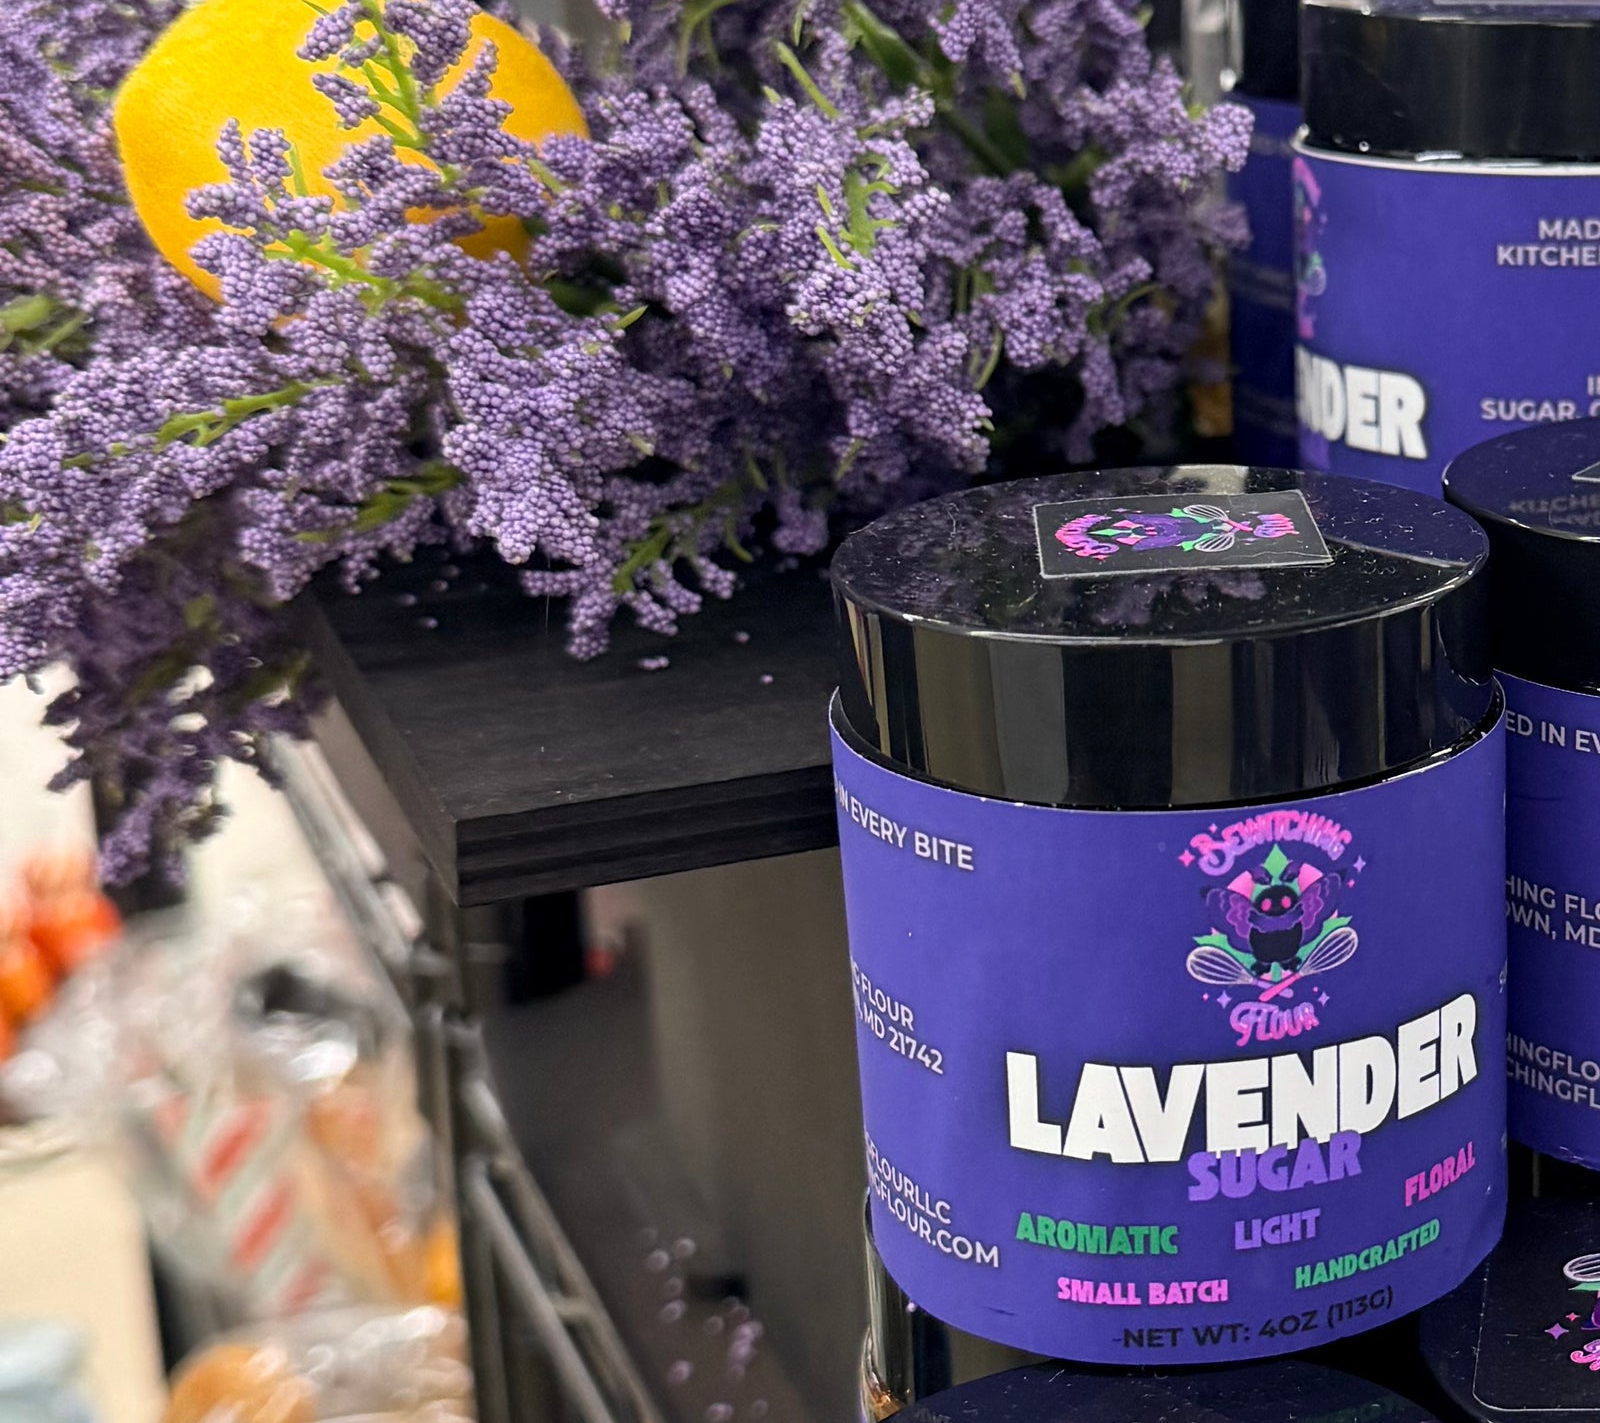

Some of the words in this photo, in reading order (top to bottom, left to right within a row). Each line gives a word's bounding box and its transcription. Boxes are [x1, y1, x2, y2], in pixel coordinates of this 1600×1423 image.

[1541, 720, 1567, 748] IN
[850, 795, 908, 849] EVERY
[914, 830, 975, 872] BITE
[1190, 810, 1352, 876] BEWITCHING
[861, 976, 915, 1032] FLOUR
[1229, 1000, 1320, 1048] FLOUR
[864, 1005, 886, 1040] MD
[888, 1026, 944, 1075] 21742
[1006, 993, 1478, 1164] LAVENDER
[1186, 1130, 1363, 1203] SUGAR
[1404, 1141, 1477, 1209] FLORAL
[1015, 1212, 1179, 1256] AROMATIC
[1234, 1207, 1322, 1251] LIGHT
[1294, 1218, 1441, 1291] HANDCRAFTED
[1056, 1277, 1142, 1307] SMALL
[1148, 1277, 1229, 1306] BATCH
[1122, 1327, 1181, 1350] NET
[1192, 1321, 1251, 1348] WT:
[1258, 1311, 1320, 1340] 4OZ
[1326, 1284, 1394, 1330] (113G)
